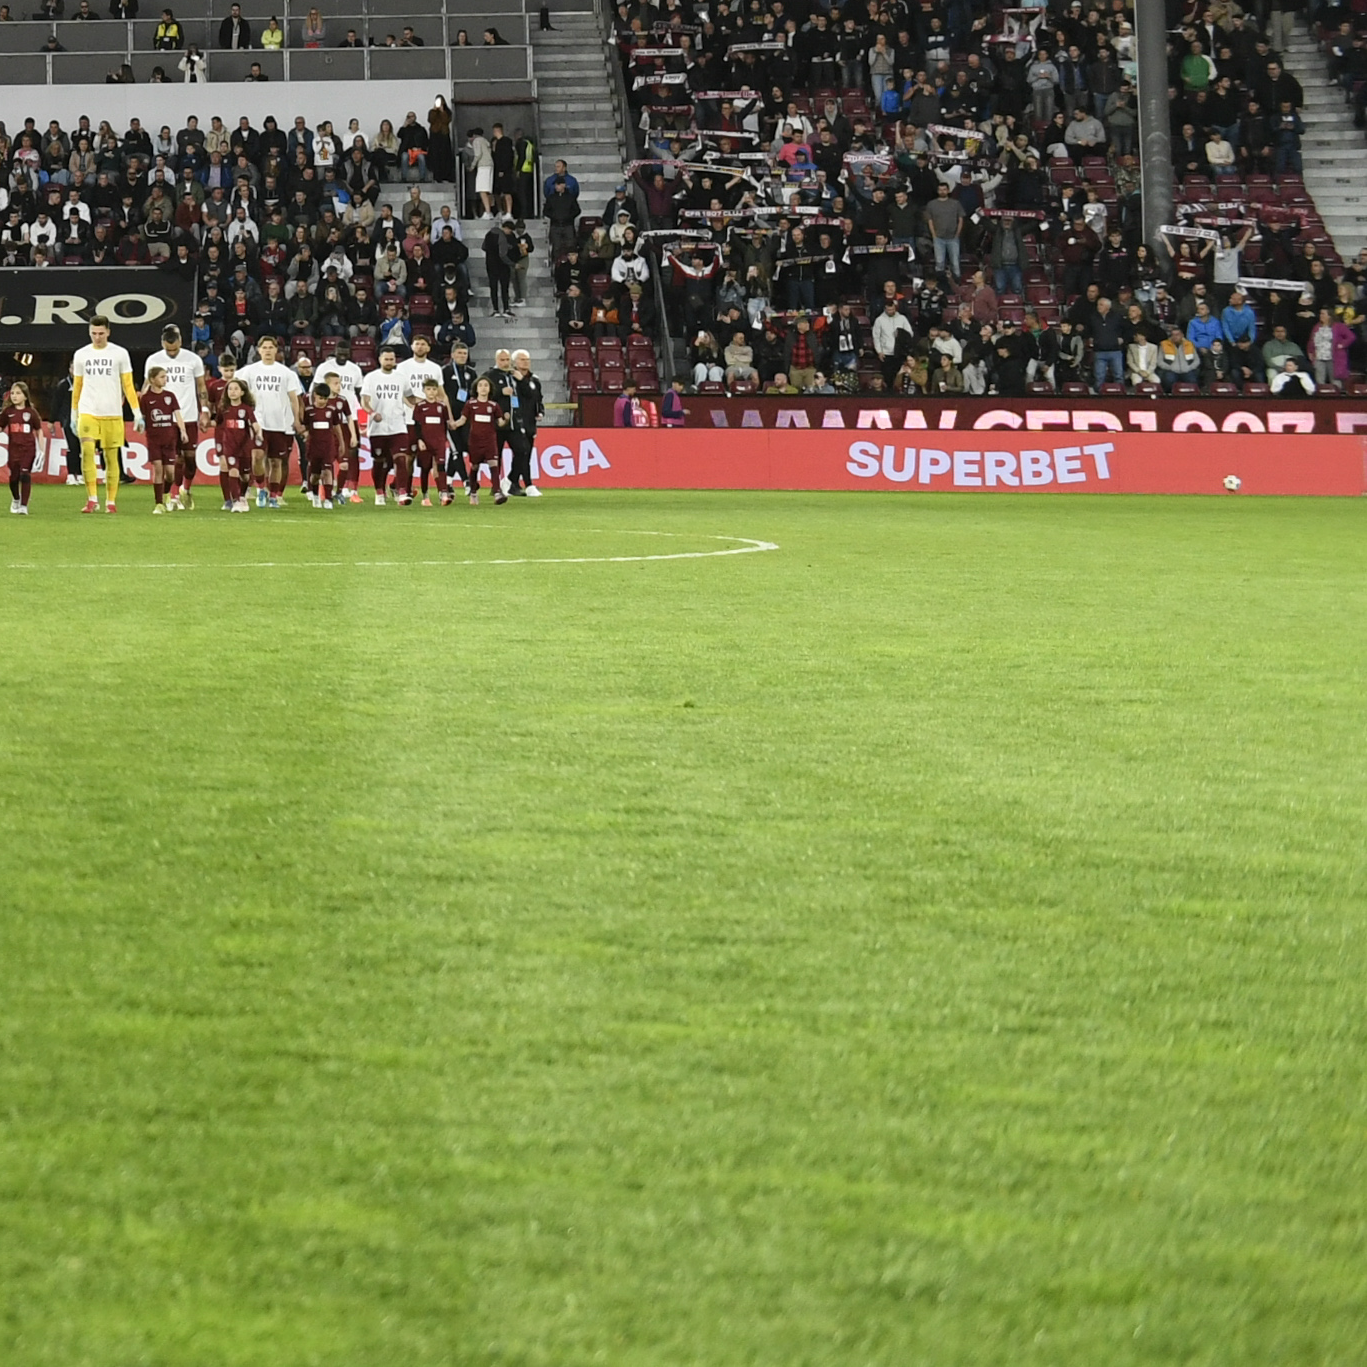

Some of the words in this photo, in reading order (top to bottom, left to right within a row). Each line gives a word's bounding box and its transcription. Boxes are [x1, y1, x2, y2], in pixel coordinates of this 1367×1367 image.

[85, 358, 113, 367] ANDI
[255, 375, 281, 383] ANDI
[255, 383, 281, 392] VIVE
[376, 383, 400, 392] ANDI
[376, 391, 399, 400] VIVE
[846, 441, 1114, 486] SUPERBET
